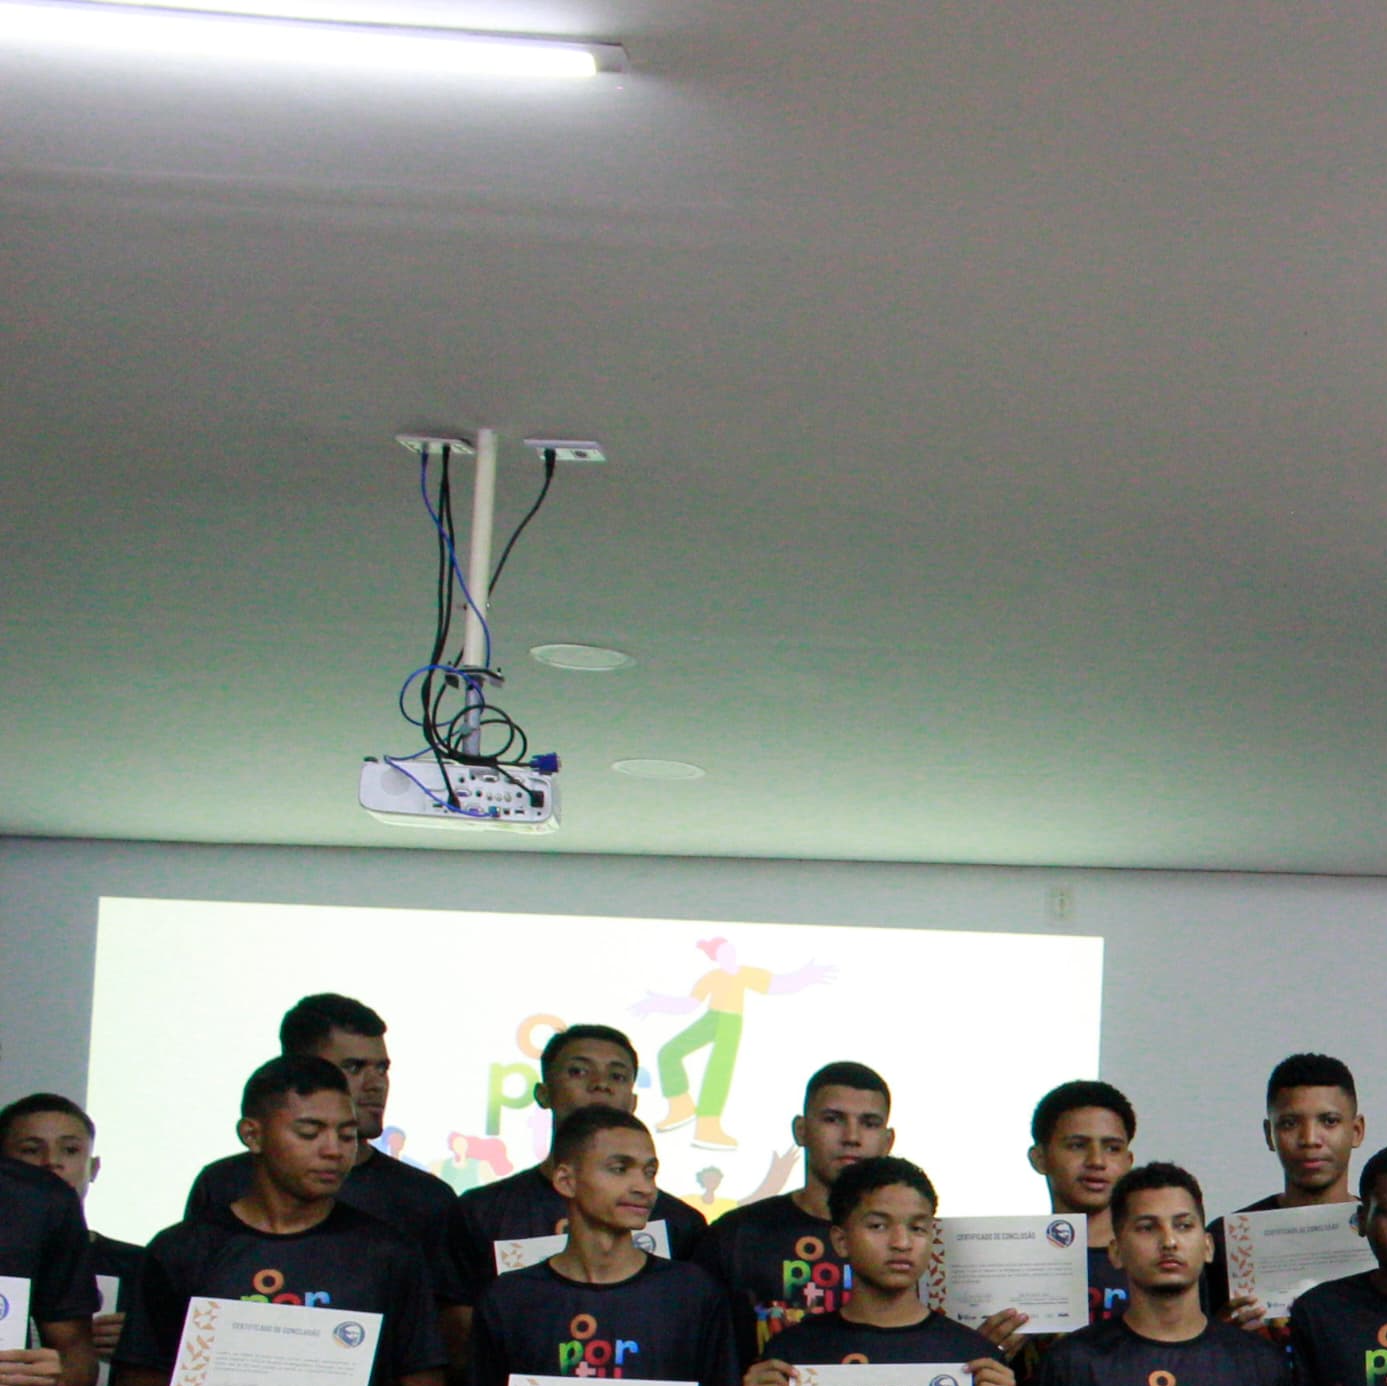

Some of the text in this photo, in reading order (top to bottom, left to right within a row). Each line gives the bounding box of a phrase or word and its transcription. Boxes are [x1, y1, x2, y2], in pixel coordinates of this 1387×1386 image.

[795, 1236, 825, 1261] o
[253, 1269, 284, 1295] o
[570, 1313, 598, 1340] o
[559, 1339, 639, 1376] por
